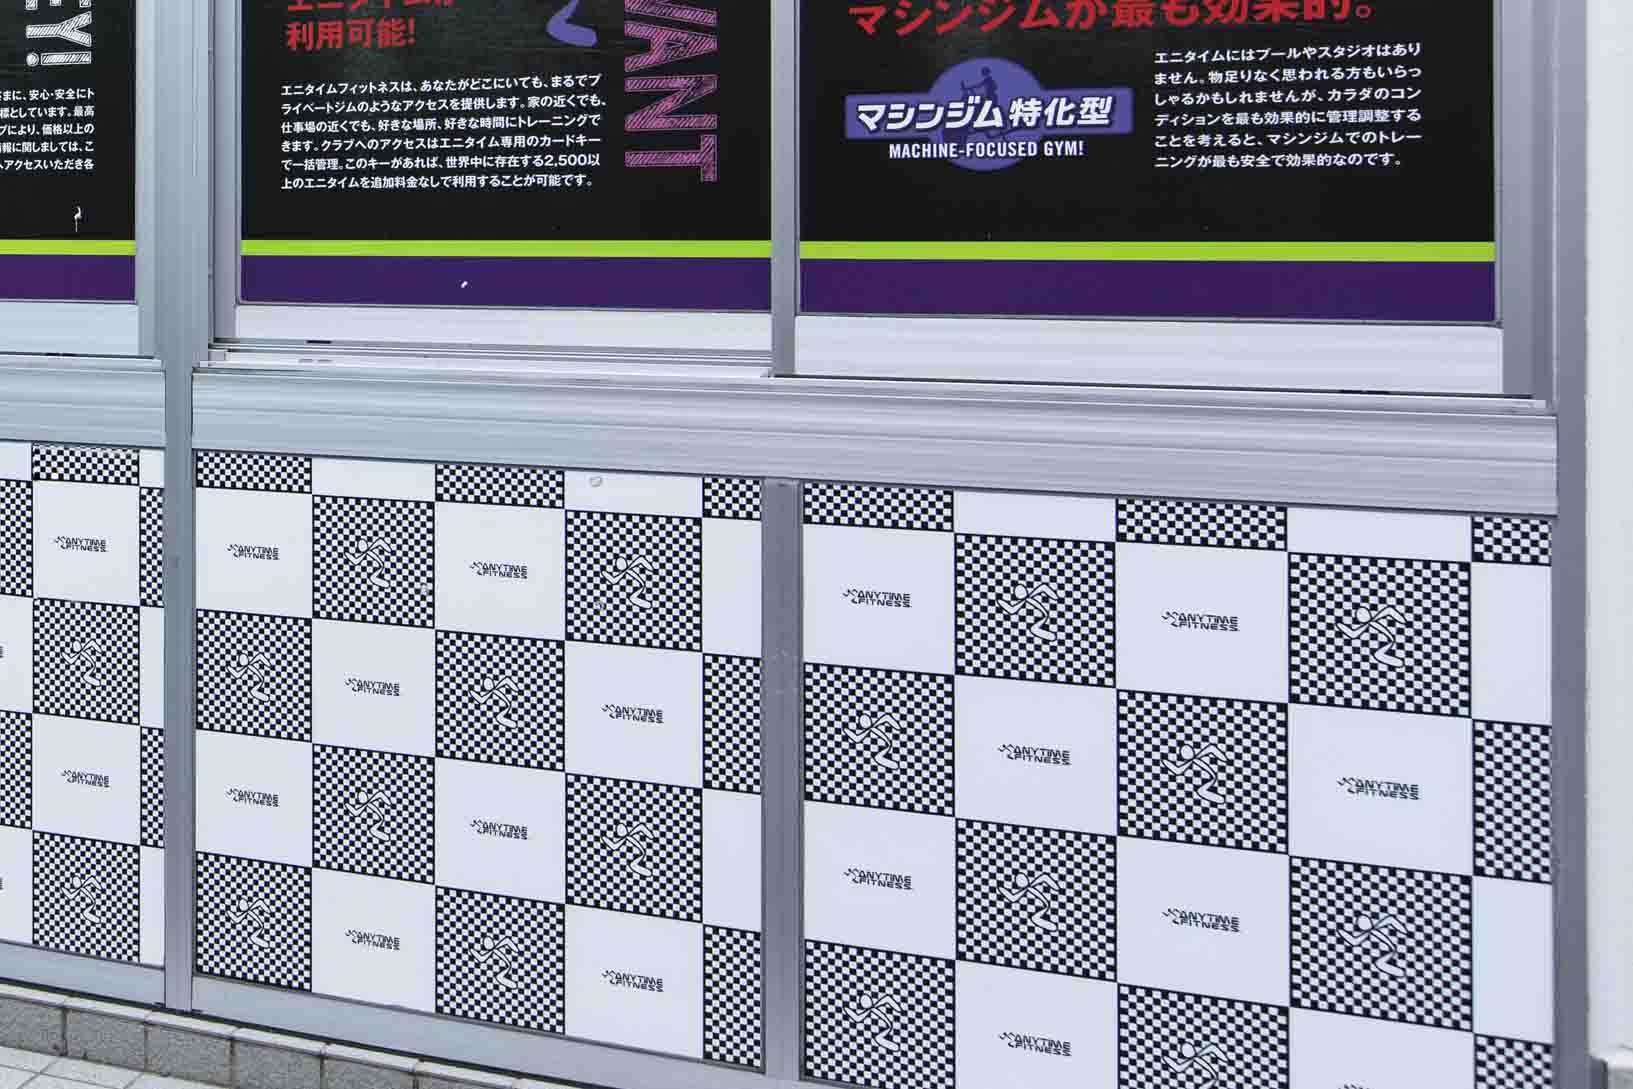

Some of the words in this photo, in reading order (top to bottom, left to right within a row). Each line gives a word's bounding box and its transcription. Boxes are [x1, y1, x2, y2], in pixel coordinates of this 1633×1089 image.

[857, 96, 1113, 131] マシンジム特化型
[889, 141, 1038, 159] MACHINE-FOCUSED
[1044, 140, 1085, 157] GYM!
[481, 563, 527, 573] ANYTIME
[481, 570, 527, 579] FITNESS
[856, 590, 910, 601] ANYTIME
[857, 598, 912, 608] FITNESS
[1177, 613, 1238, 625] ANYTIME
[1177, 621, 1240, 631] FITNESS
[614, 706, 662, 718] ANYTIME
[614, 713, 664, 724] FITNESS
[1012, 746, 1070, 759] ANYTIME
[1012, 753, 1072, 765] FITNESS
[1354, 779, 1418, 793] ANYTIME
[1354, 787, 1420, 800] FITNESS
[481, 822, 527, 834] ANYTIME
[481, 828, 527, 840] FITNESS
[857, 870, 911, 884] ANYTIME
[858, 878, 912, 890] FITNESS
[1178, 911, 1239, 925] ANYTIME
[1178, 918, 1240, 932] FITNESS
[614, 972, 663, 986] ANYTIME
[614, 979, 664, 992] FITNESS
[1014, 1034, 1070, 1050] ANYTIME
[1014, 1042, 1072, 1056] FITNESS
